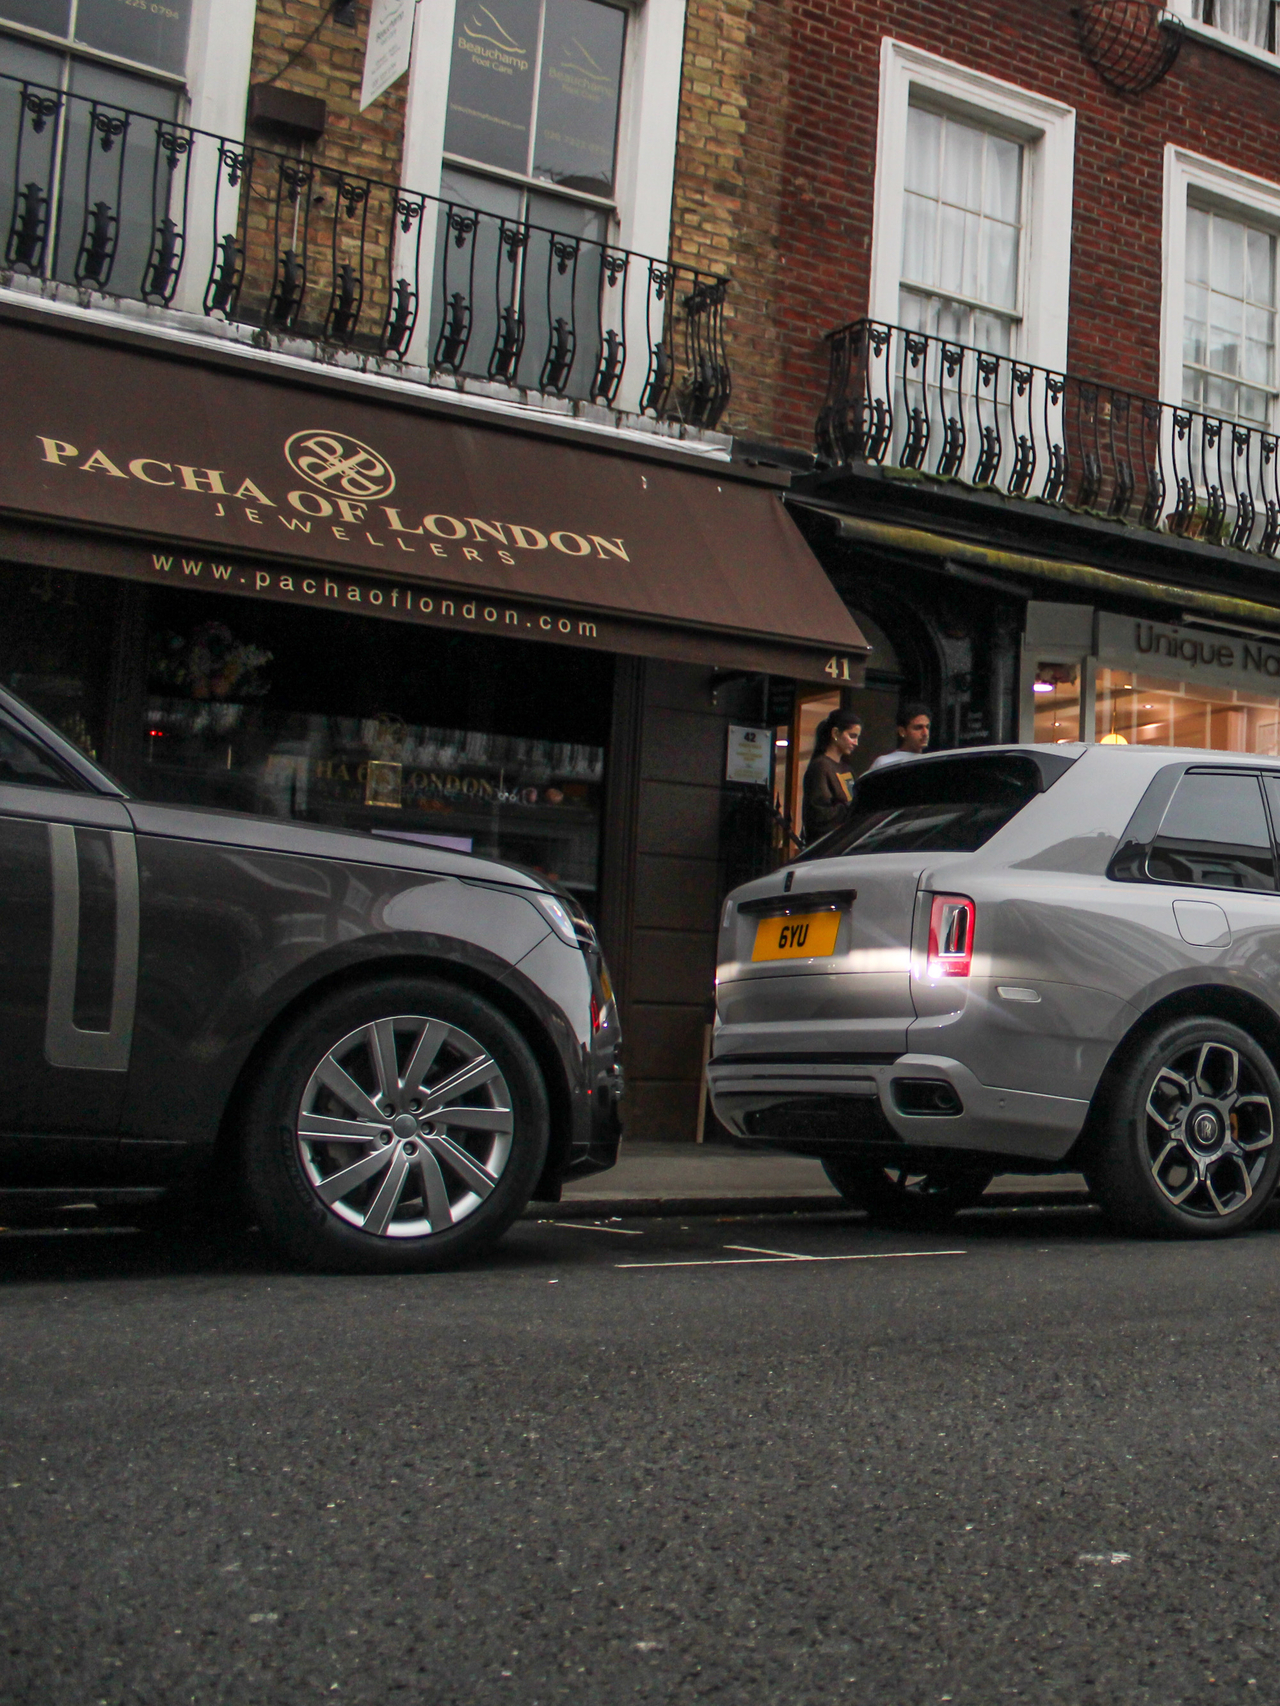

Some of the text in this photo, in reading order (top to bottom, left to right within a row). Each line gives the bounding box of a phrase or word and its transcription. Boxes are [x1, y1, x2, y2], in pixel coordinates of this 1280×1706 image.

[458, 37, 529, 71] Beauchamp
[36, 435, 631, 562] PACHA OF LONDON
[215, 503, 516, 565] JEWELLERS
[152, 554, 598, 638] www.pachaoflondon.com
[1135, 622, 1234, 668] Unique
[824, 655, 852, 681] 41
[743, 731, 757, 743] 42
[778, 923, 809, 949] 6YU
